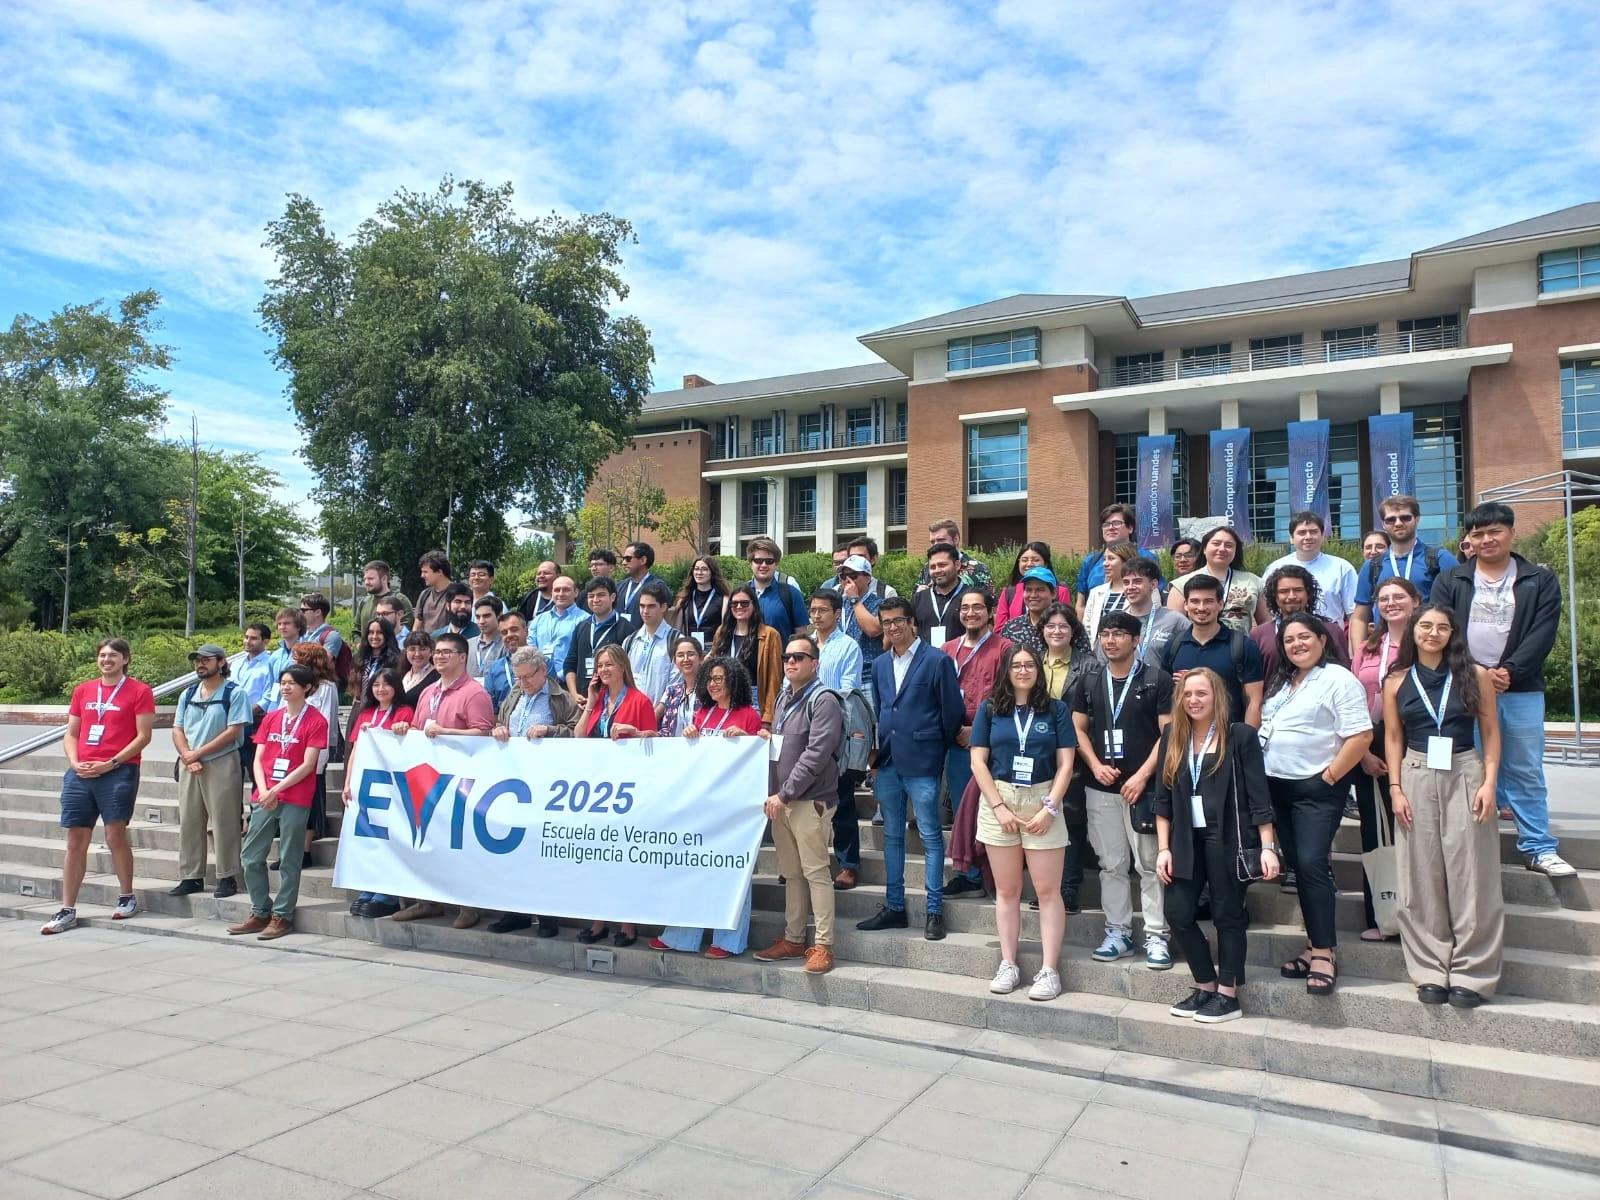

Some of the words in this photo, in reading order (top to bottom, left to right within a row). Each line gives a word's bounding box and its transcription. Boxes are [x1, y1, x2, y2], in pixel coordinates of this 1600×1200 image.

[1224, 442, 1236, 517] Comprometida
[1304, 461, 1316, 504] Impacto
[1387, 452, 1399, 498] ociedad
[354, 763, 533, 855] EVIC
[545, 780, 636, 814] 2025
[542, 822, 596, 841] Escuela
[601, 824, 619, 842] de
[624, 826, 678, 845] Verano
[683, 831, 703, 846] en
[541, 842, 624, 864] Inteligencia
[628, 847, 750, 870] Computacional
[1380, 891, 1397, 900] EVI
